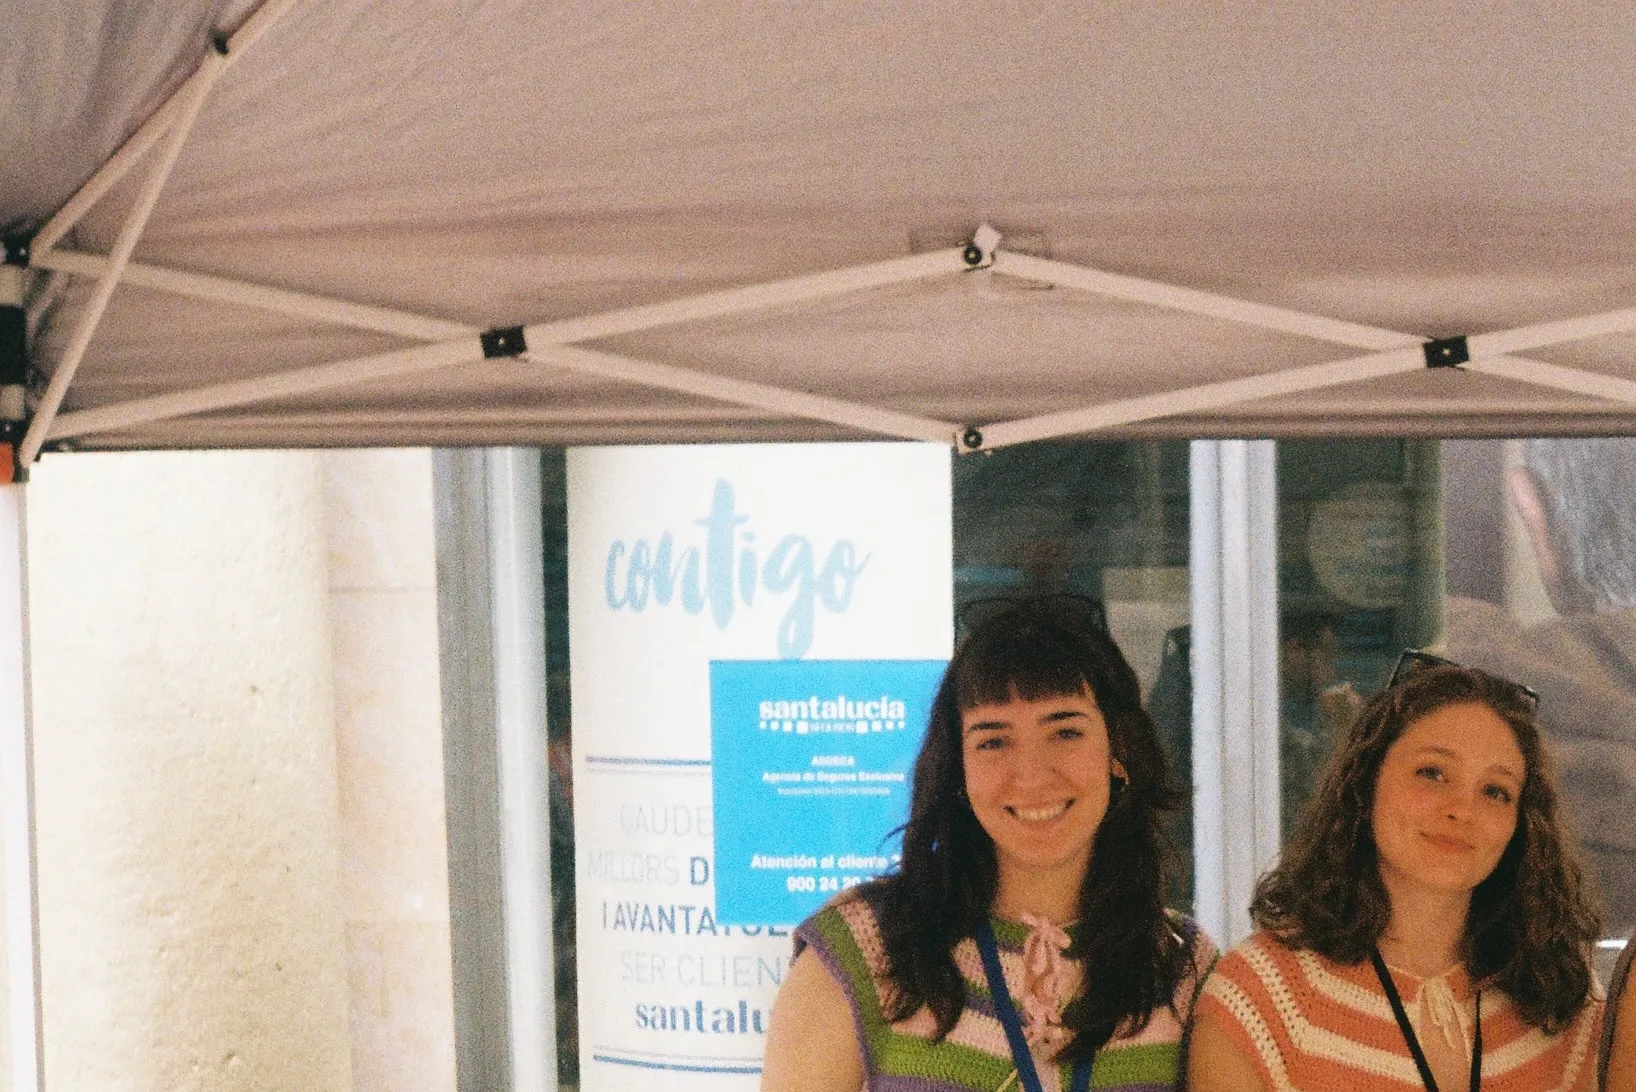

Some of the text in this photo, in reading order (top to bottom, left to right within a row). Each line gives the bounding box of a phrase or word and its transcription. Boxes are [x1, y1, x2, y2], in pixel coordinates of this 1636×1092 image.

[604, 478, 872, 659] contigo
[751, 854, 817, 870] Atención
[614, 902, 788, 937] AVANTA
[677, 955, 788, 988] CLIEN
